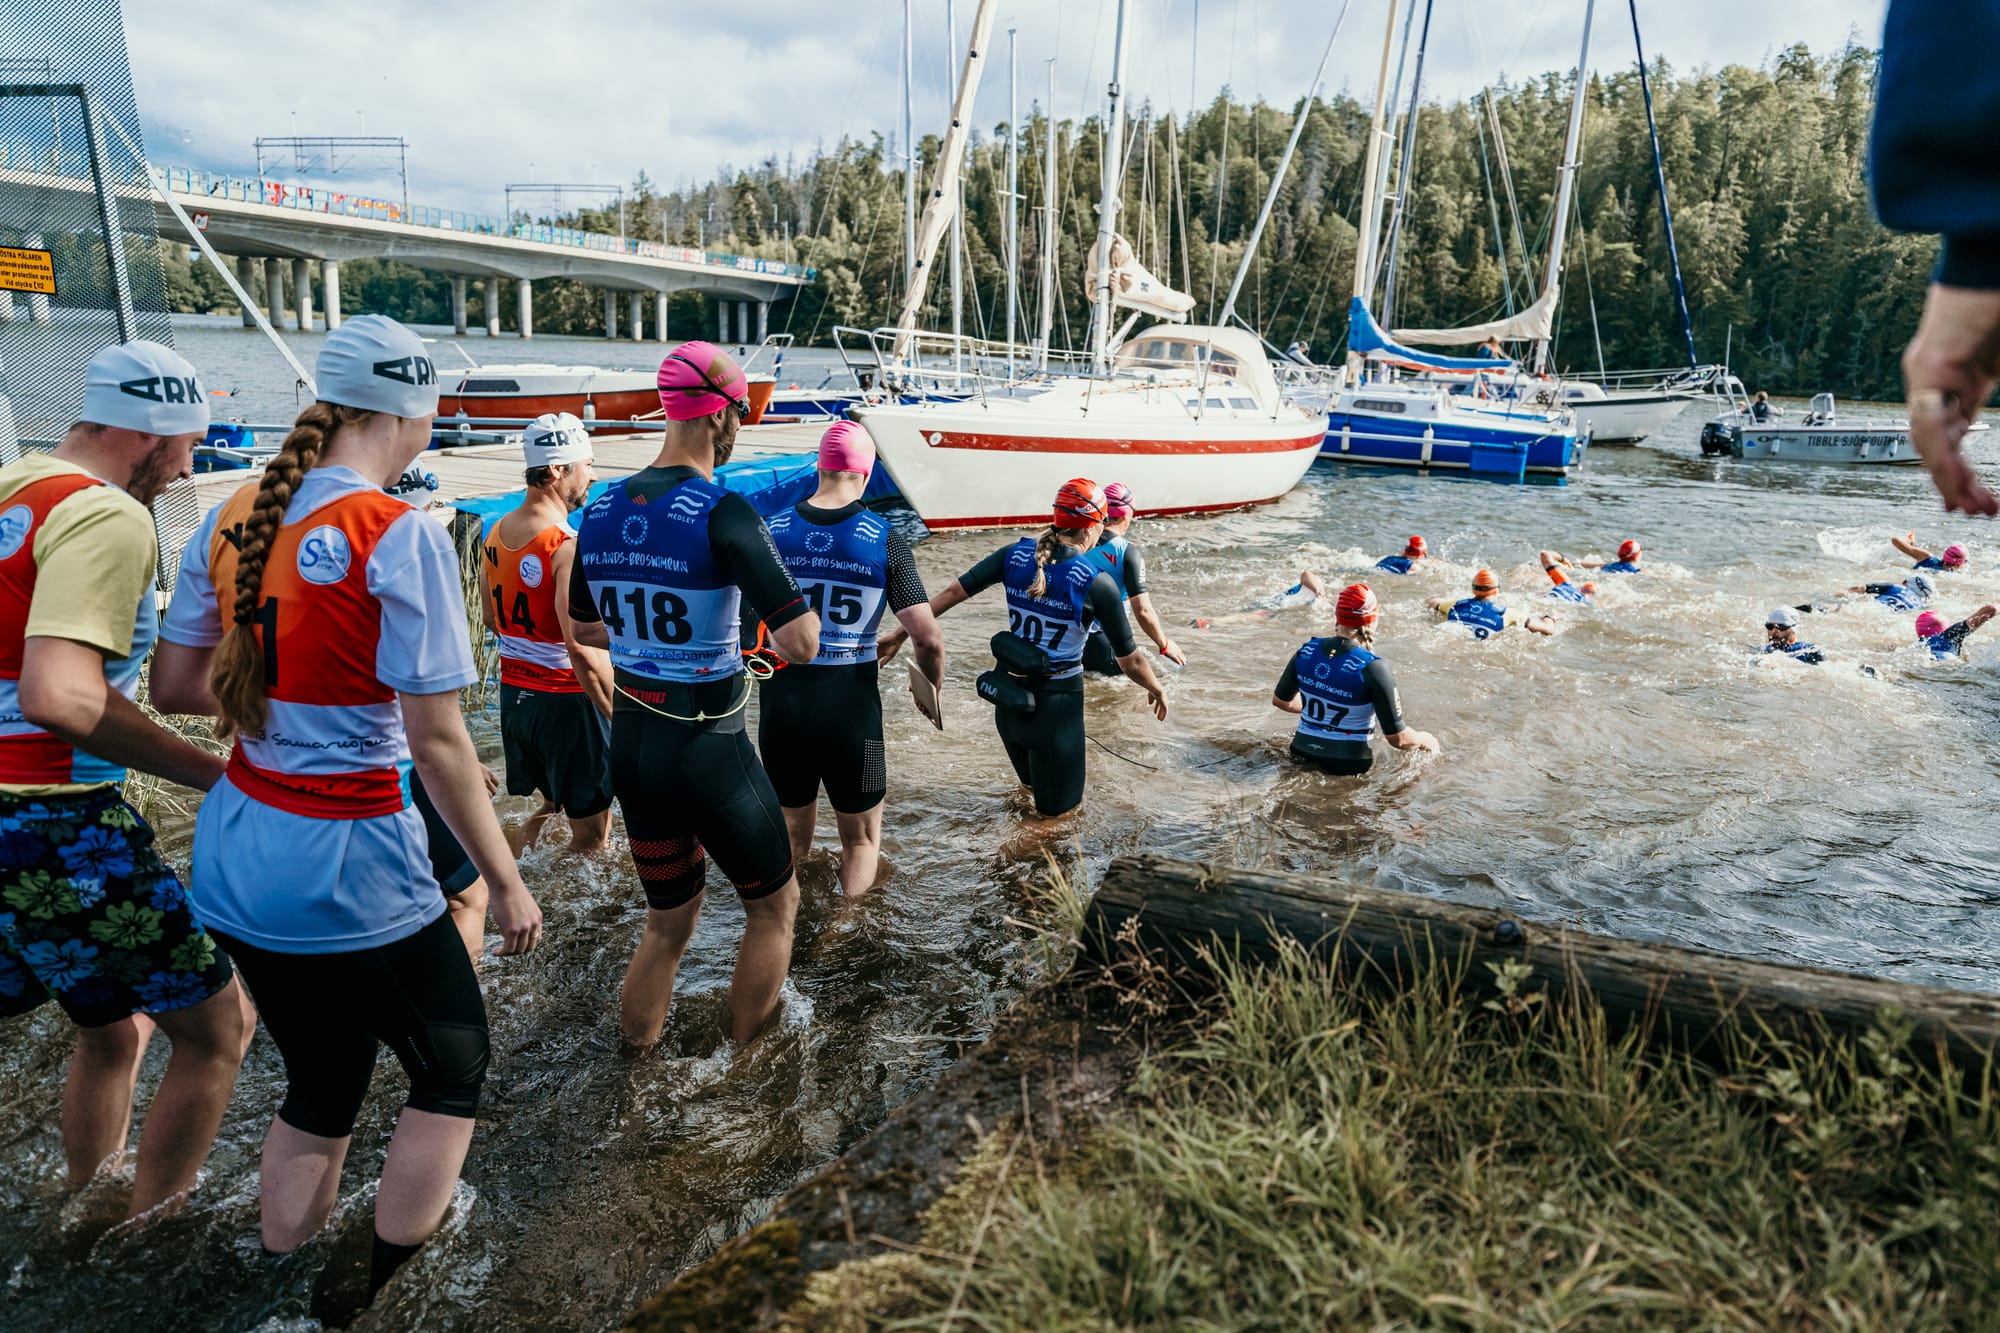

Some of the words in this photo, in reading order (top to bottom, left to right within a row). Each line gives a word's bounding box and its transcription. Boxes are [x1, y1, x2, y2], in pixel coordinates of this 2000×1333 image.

[119, 375, 204, 404] ARK
[1807, 435, 1839, 447] TIBBLE
[588, 511, 609, 520] MEDLEY
[667, 512, 696, 525] MEDLEY
[853, 532, 878, 545] MEDLEY
[829, 558, 872, 576] SWIMRUN
[492, 584, 537, 636] 14
[600, 585, 693, 645] 418
[1008, 608, 1069, 651] 207
